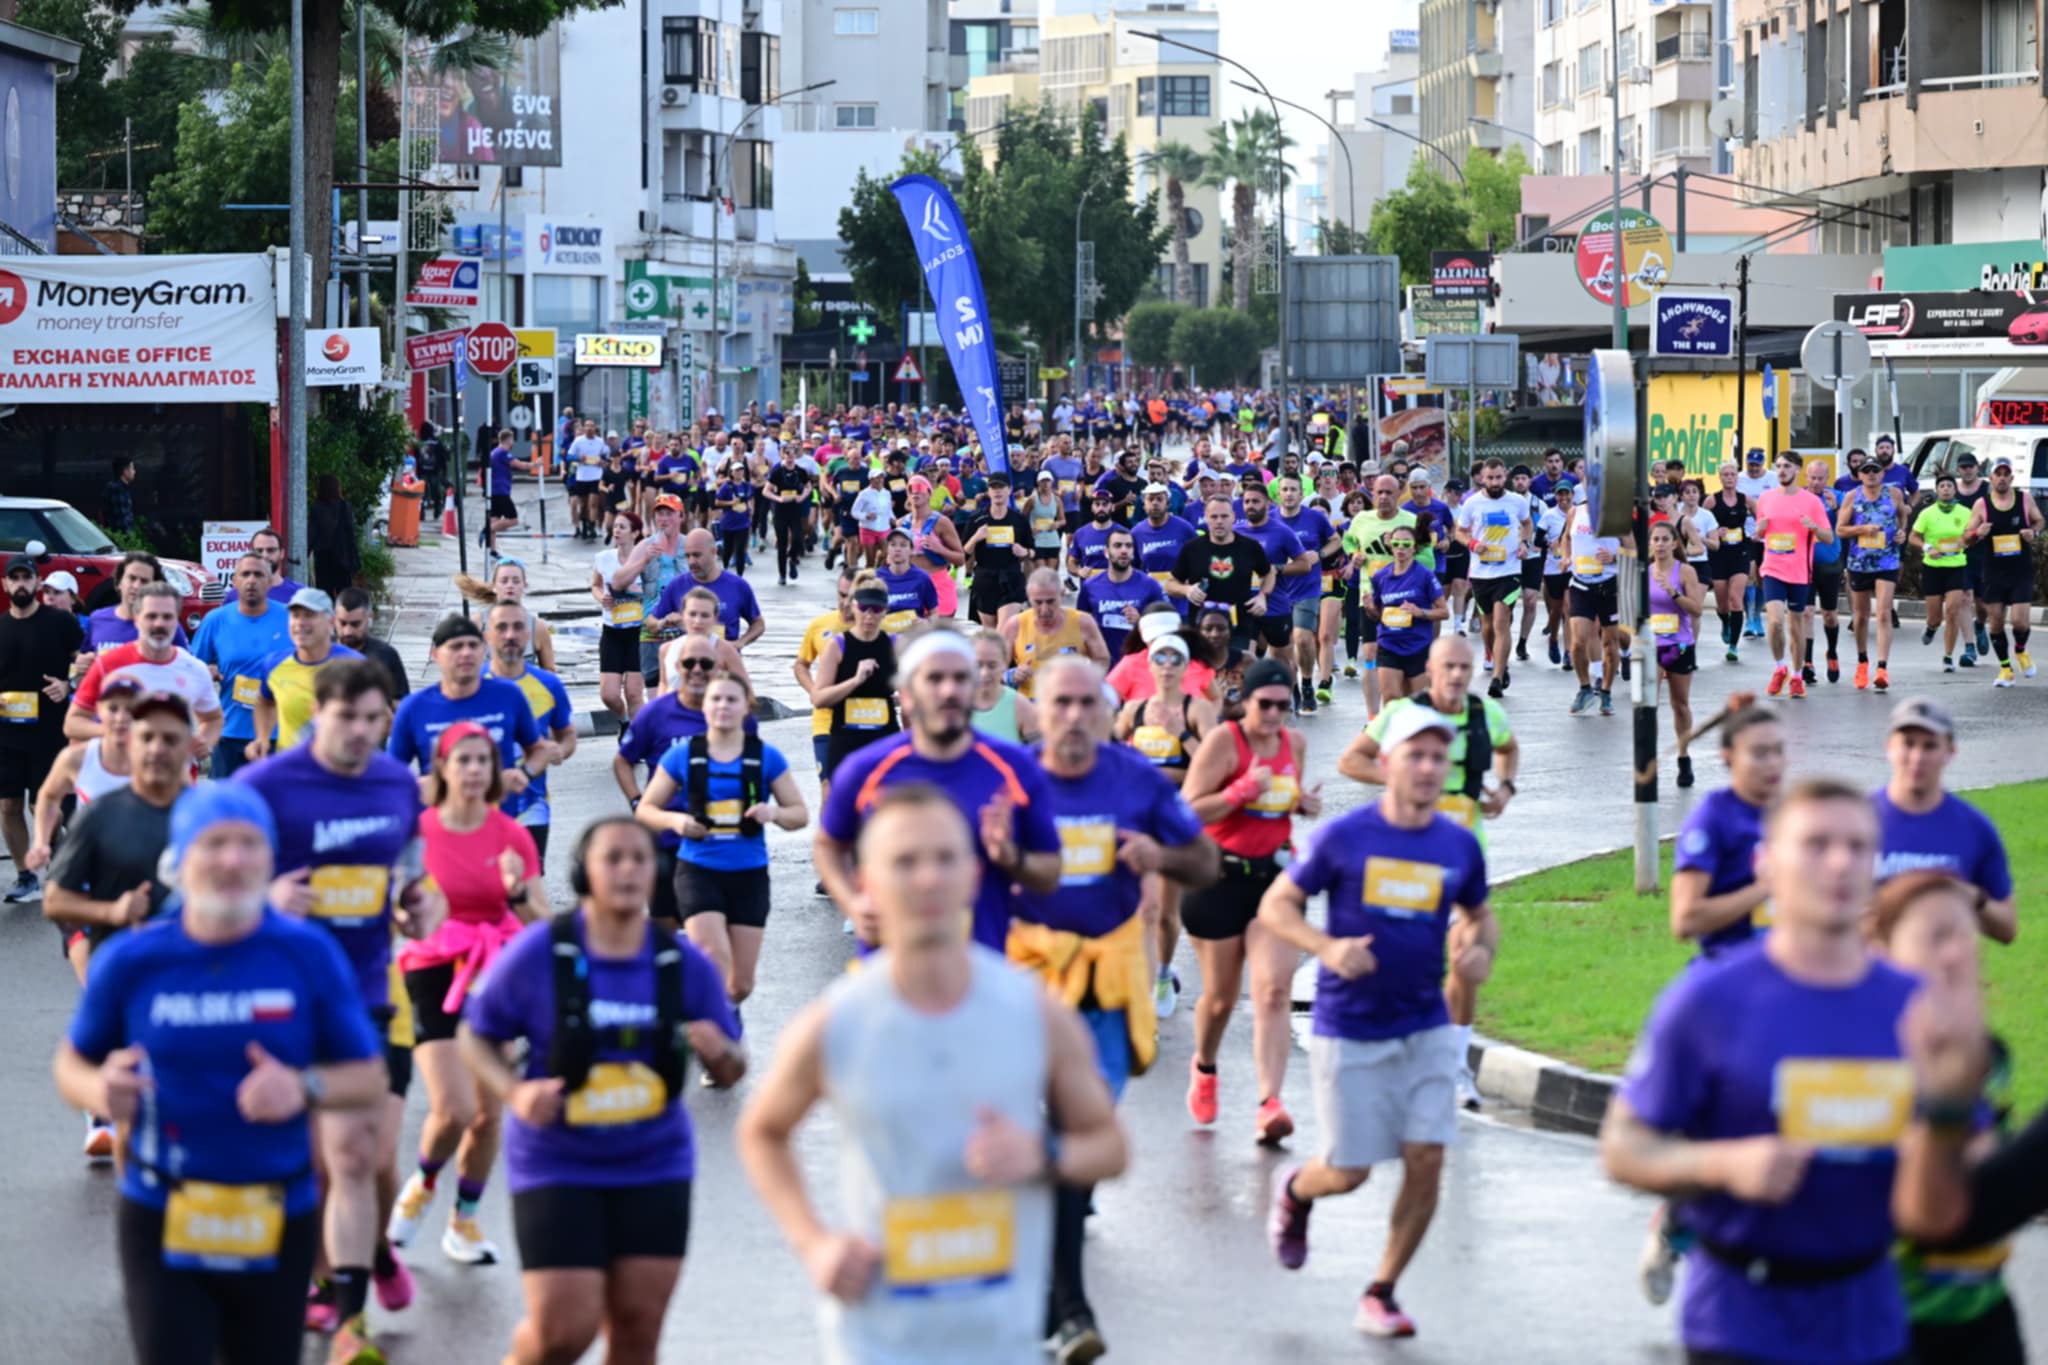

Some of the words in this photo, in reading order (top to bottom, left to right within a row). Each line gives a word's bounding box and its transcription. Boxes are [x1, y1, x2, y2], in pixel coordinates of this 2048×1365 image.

[512, 85, 552, 115] ένα
[467, 127, 494, 155] με
[498, 120, 552, 150] σένα
[37, 280, 246, 313] MoneyGram
[37, 316, 103, 334] money
[107, 311, 183, 330] transfer
[1661, 302, 1728, 324] ANONYMOUS
[1847, 304, 1901, 326] LAF
[1966, 308, 1978, 318] THE
[13, 348, 130, 365] EXCHANGE
[136, 346, 212, 362] OFFICE
[468, 336, 515, 361] STOP
[1672, 340, 1691, 350] THE
[1696, 341, 1717, 350] PUB
[87, 369, 256, 388] ΣΥΝΑΛΛΑΓΜΑΤΟΣ
[306, 365, 365, 375] MoneyGram
